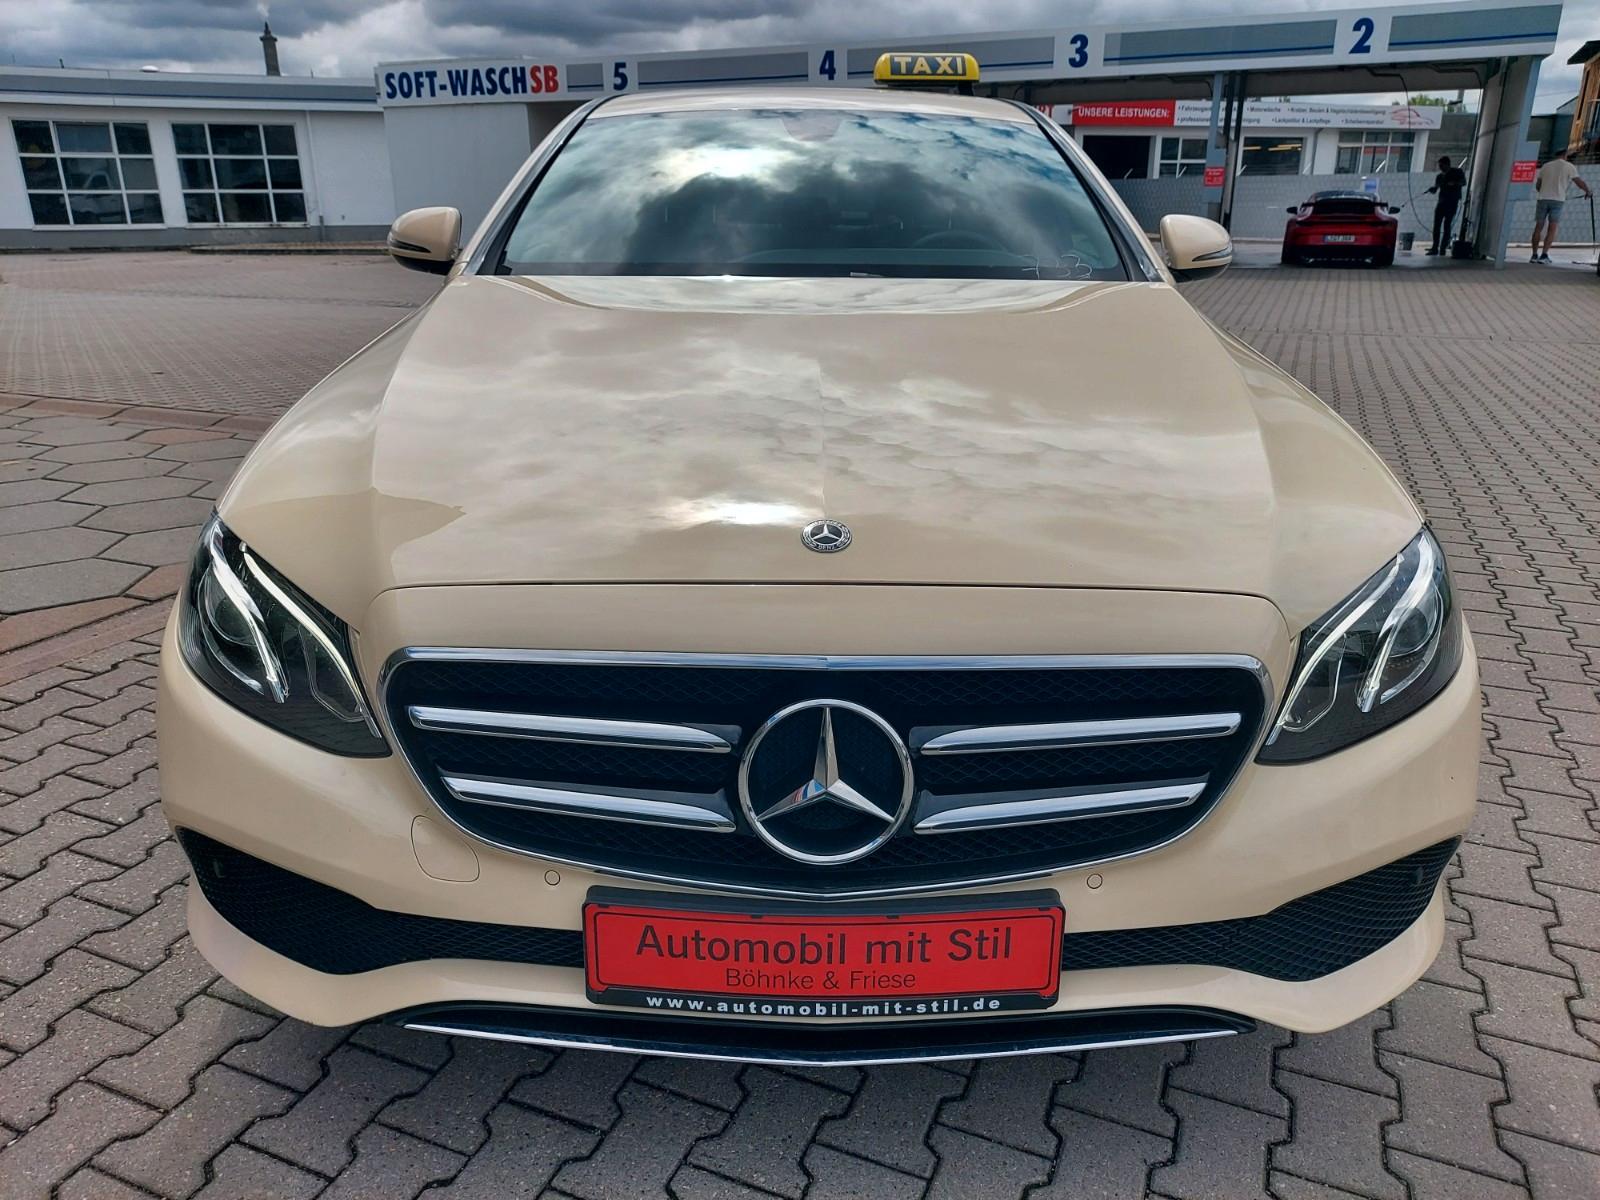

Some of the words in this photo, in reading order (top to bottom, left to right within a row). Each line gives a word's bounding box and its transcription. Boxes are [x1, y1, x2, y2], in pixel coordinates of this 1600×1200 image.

[1349, 17, 1375, 54] 2
[819, 50, 837, 80] 4
[893, 55, 965, 76] TAXI
[1068, 34, 1090, 68] 3
[612, 61, 629, 91] 5
[1078, 105, 1112, 117] UNSERE
[636, 924, 846, 967] Automobil
[866, 930, 932, 965] mit
[947, 926, 1012, 962] Stil
[725, 966, 814, 990] Böhnke
[822, 970, 840, 990] &
[849, 970, 917, 990] Friese
[646, 995, 1002, 1017] www.automobil-mit-stil.de
